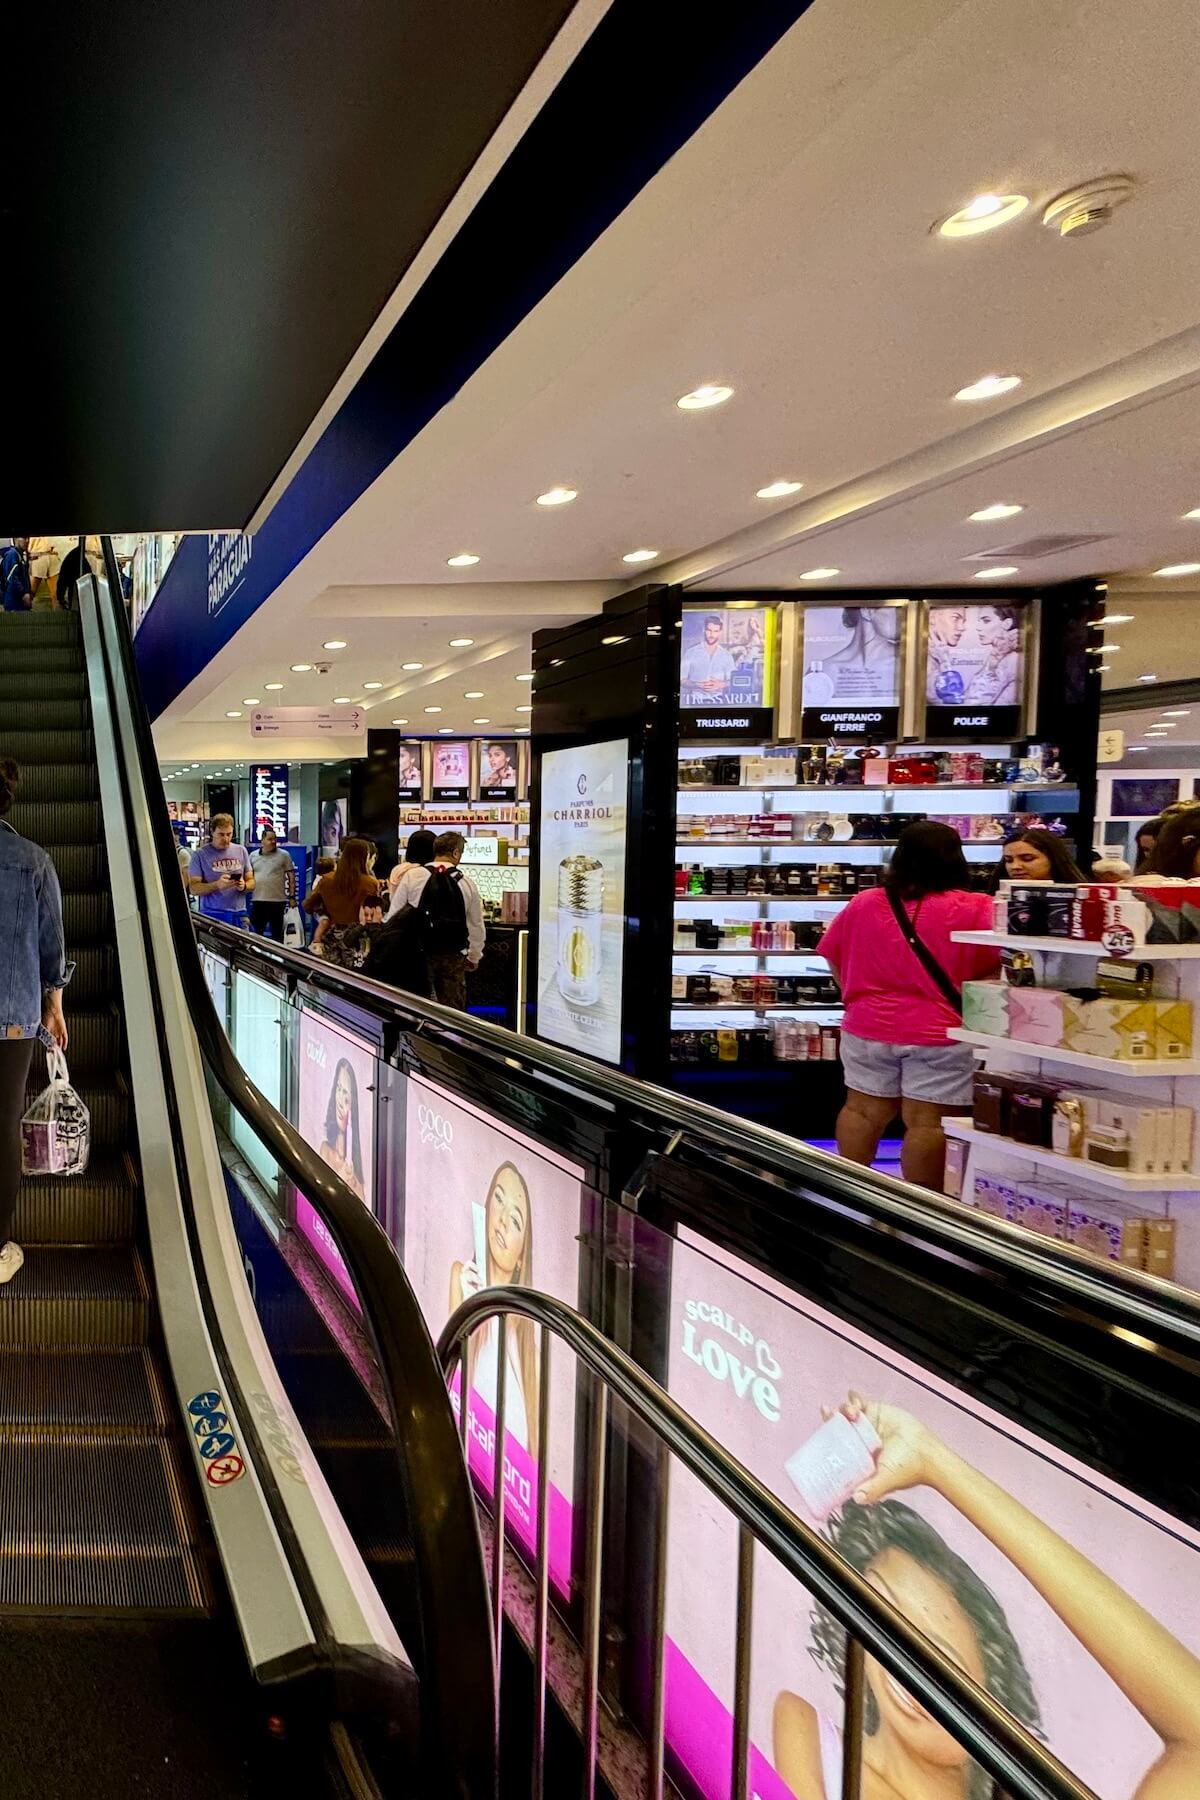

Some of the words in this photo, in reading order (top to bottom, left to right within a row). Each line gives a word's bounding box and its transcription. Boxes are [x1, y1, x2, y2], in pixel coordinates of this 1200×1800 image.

[208, 535, 253, 614] PARAGUAY
[820, 713, 882, 722] GIANFRANCO
[953, 717, 989, 726] POLICE
[696, 719, 749, 728] TRUSSARDI
[833, 723, 866, 732] FERRE
[553, 807, 612, 821] CHARRIOL
[504, 1486, 531, 1526] ONDON
